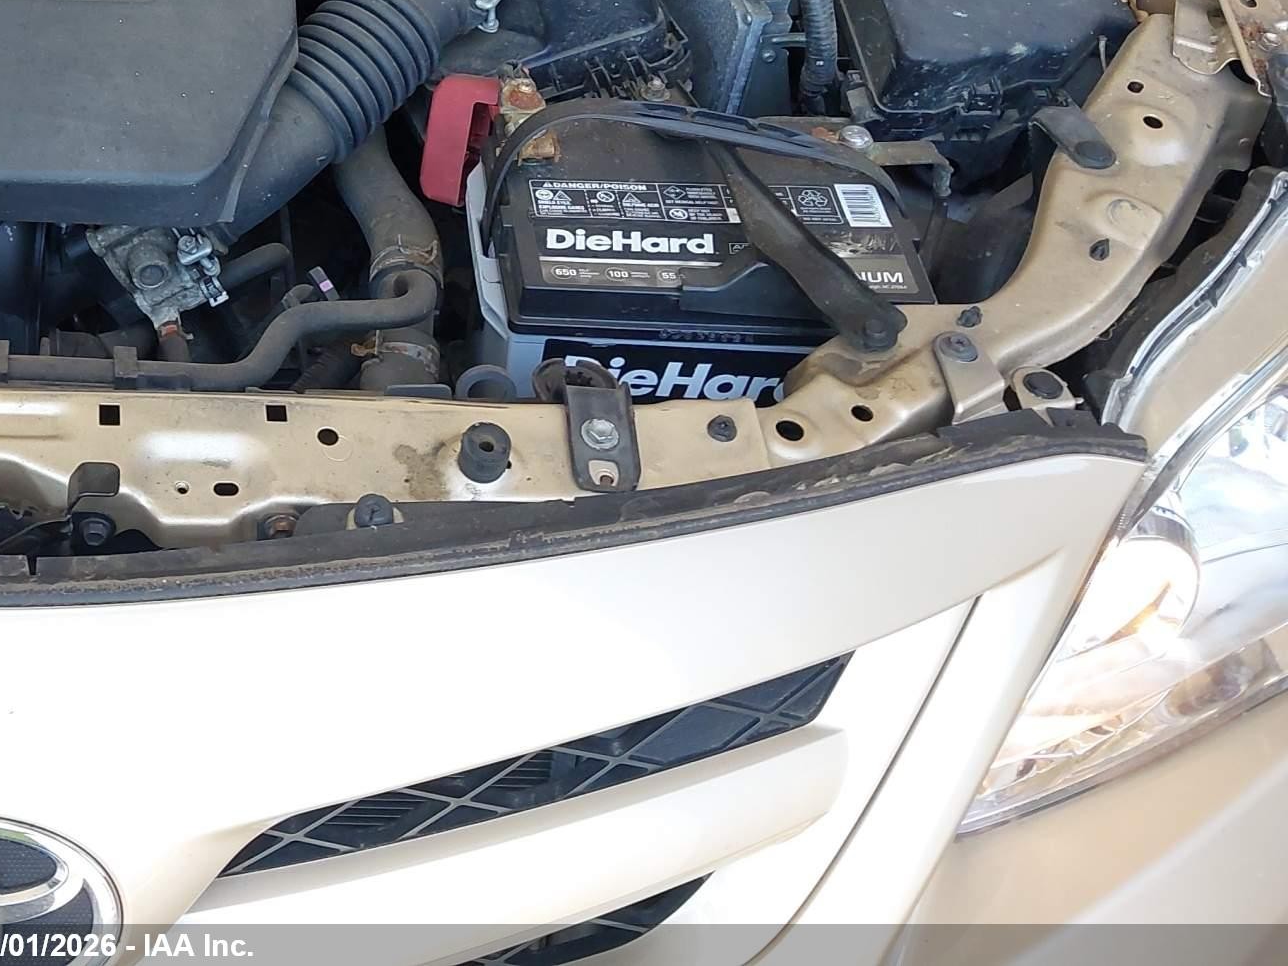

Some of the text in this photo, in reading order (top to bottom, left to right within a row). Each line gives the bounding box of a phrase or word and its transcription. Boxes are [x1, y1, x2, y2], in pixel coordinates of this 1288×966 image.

[553, 182, 647, 191] DANGER/POISON
[546, 228, 715, 255] DieHard
[555, 267, 577, 277] 650
[608, 269, 629, 279] 100
[564, 355, 785, 403] ieHar
